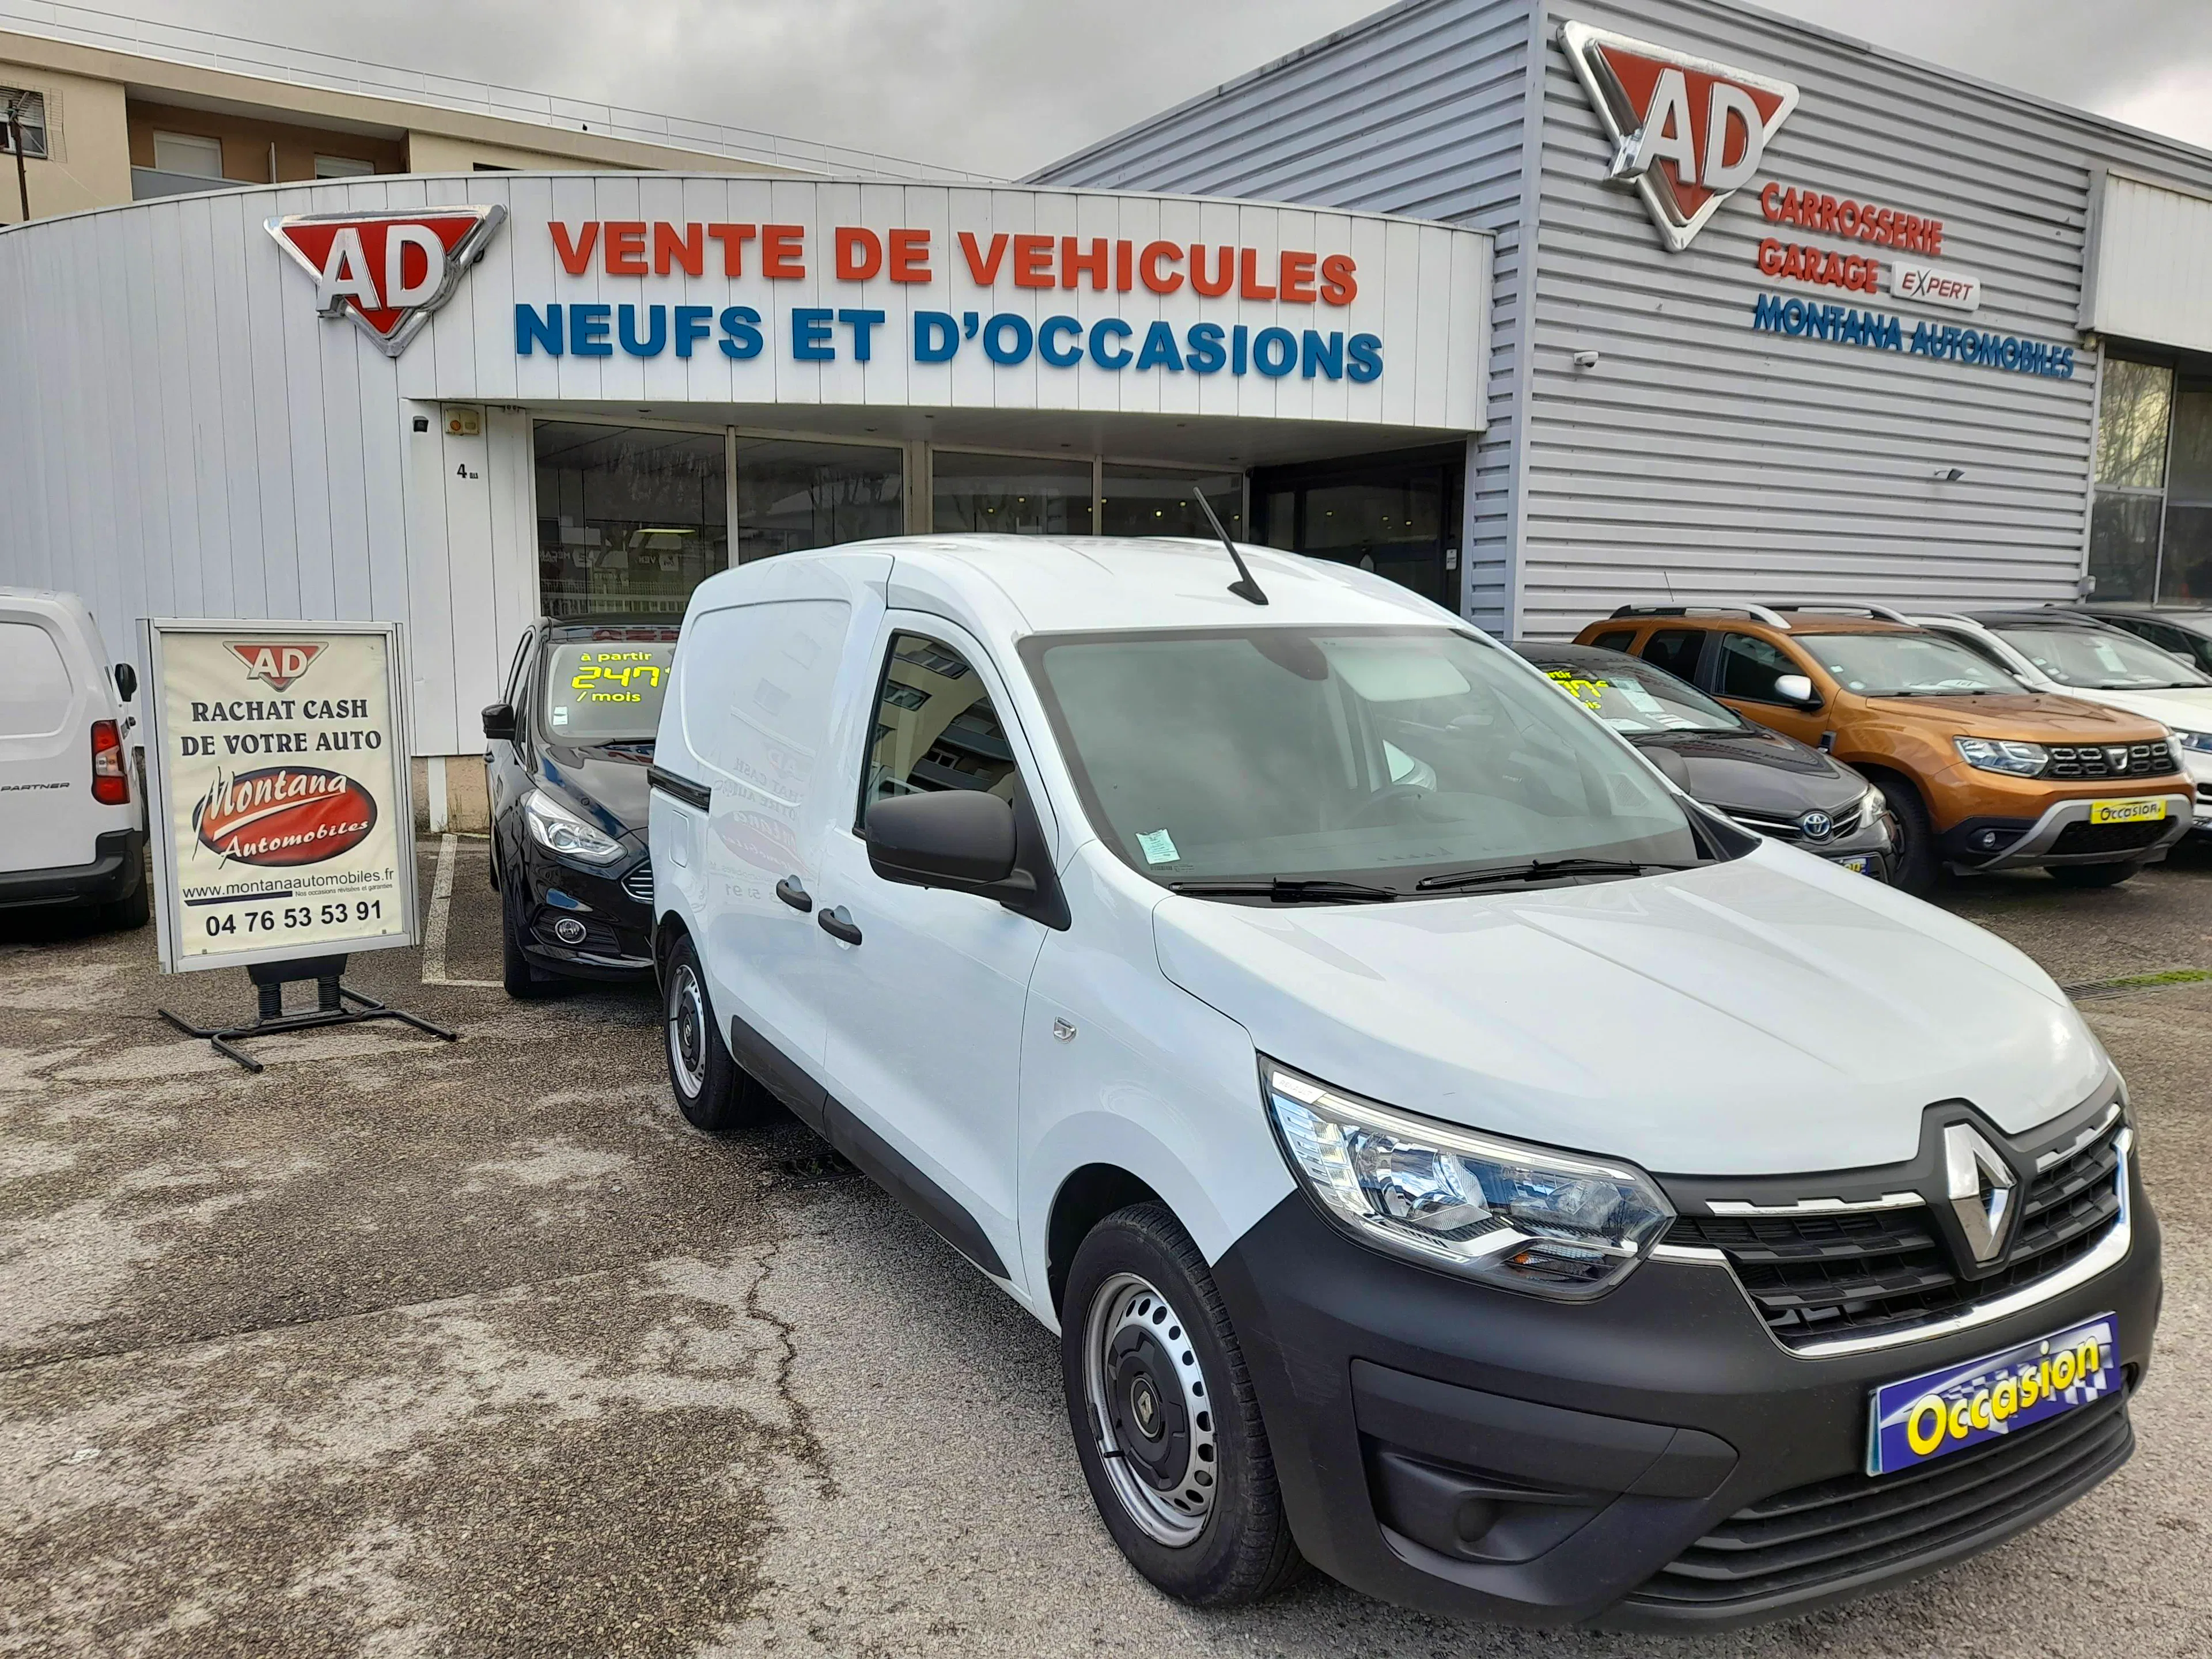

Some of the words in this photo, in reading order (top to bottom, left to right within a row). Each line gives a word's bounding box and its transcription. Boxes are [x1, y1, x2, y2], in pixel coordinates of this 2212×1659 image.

[1630, 68, 1764, 190] AD
[1760, 182, 1944, 255] CARROSSERIE
[316, 225, 446, 312] AD
[547, 221, 805, 279] VENTE
[835, 226, 931, 282] DE
[957, 231, 1357, 306] VEHICULES
[1758, 236, 1880, 294] GARAGE
[516, 304, 763, 359] NEUFS
[791, 308, 885, 361] ET
[1753, 293, 1903, 353] MONTANA
[1910, 321, 2074, 379] AUTOMOBILES
[457, 464, 467, 478] 4
[250, 648, 308, 678] AD
[580, 652, 592, 661] à
[597, 652, 653, 662] partir
[191, 700, 296, 722] RACHAT
[303, 699, 369, 719] CASH
[592, 692, 641, 702] mois
[181, 736, 216, 756] DE
[223, 733, 308, 755] VOTRE
[316, 730, 381, 751] AUTO
[1, 782, 70, 791] PARTNER
[2100, 804, 2157, 820] Occasion
[218, 820, 369, 869] Automobiles
[183, 868, 394, 899] www.montanaautomobiles.fr
[206, 914, 236, 937] 04
[245, 910, 274, 933] 76
[283, 907, 312, 929] 53
[321, 903, 348, 925] 53
[356, 899, 381, 921] 91
[1907, 1336, 2101, 1456] Occasion
